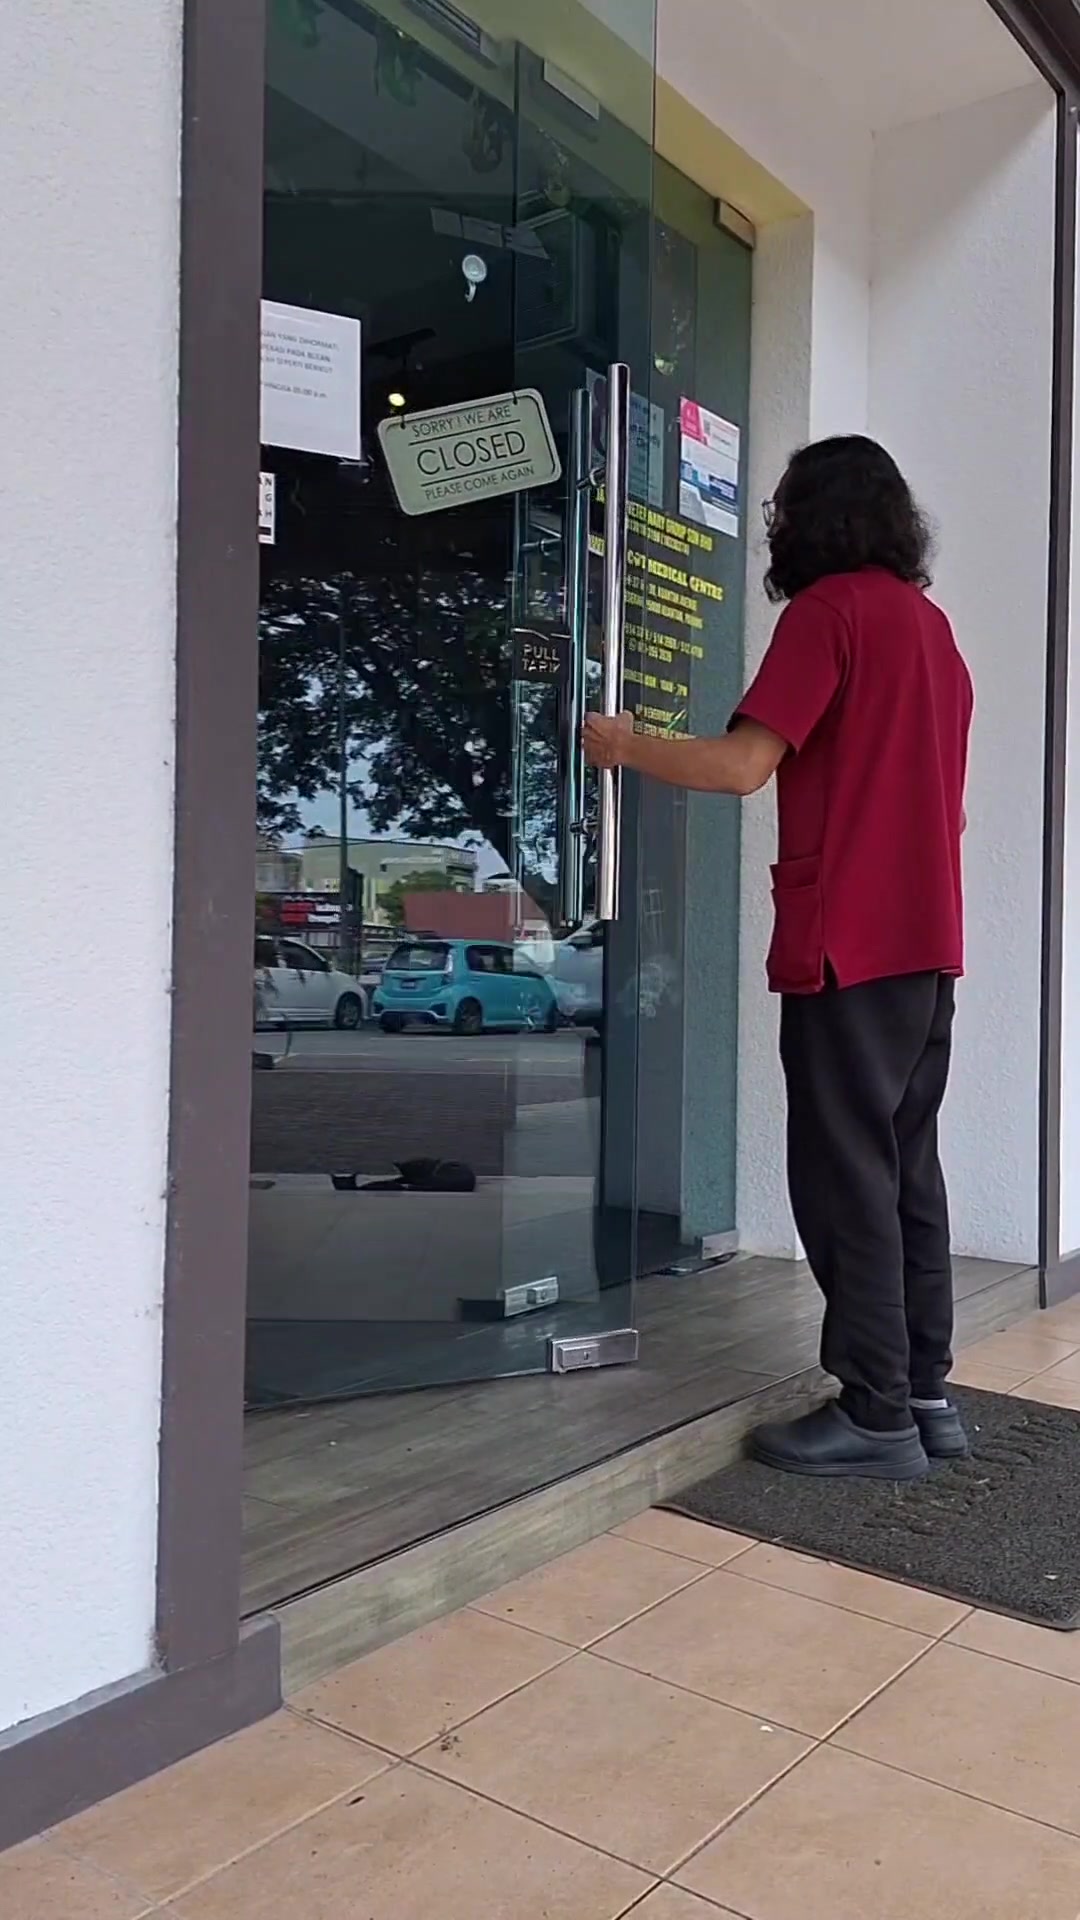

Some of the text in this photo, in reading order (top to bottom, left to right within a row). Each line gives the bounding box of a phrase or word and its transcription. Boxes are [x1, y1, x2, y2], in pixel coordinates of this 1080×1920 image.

[412, 418, 454, 438] SORRY
[463, 412, 484, 425] WE
[488, 405, 512, 421] ARE
[416, 430, 526, 476] CLOSED
[425, 466, 535, 501] PLEASE COME AGAIN
[647, 558, 689, 588] MEDICAL
[689, 575, 723, 602] CENTRE
[523, 643, 560, 661] PULL
